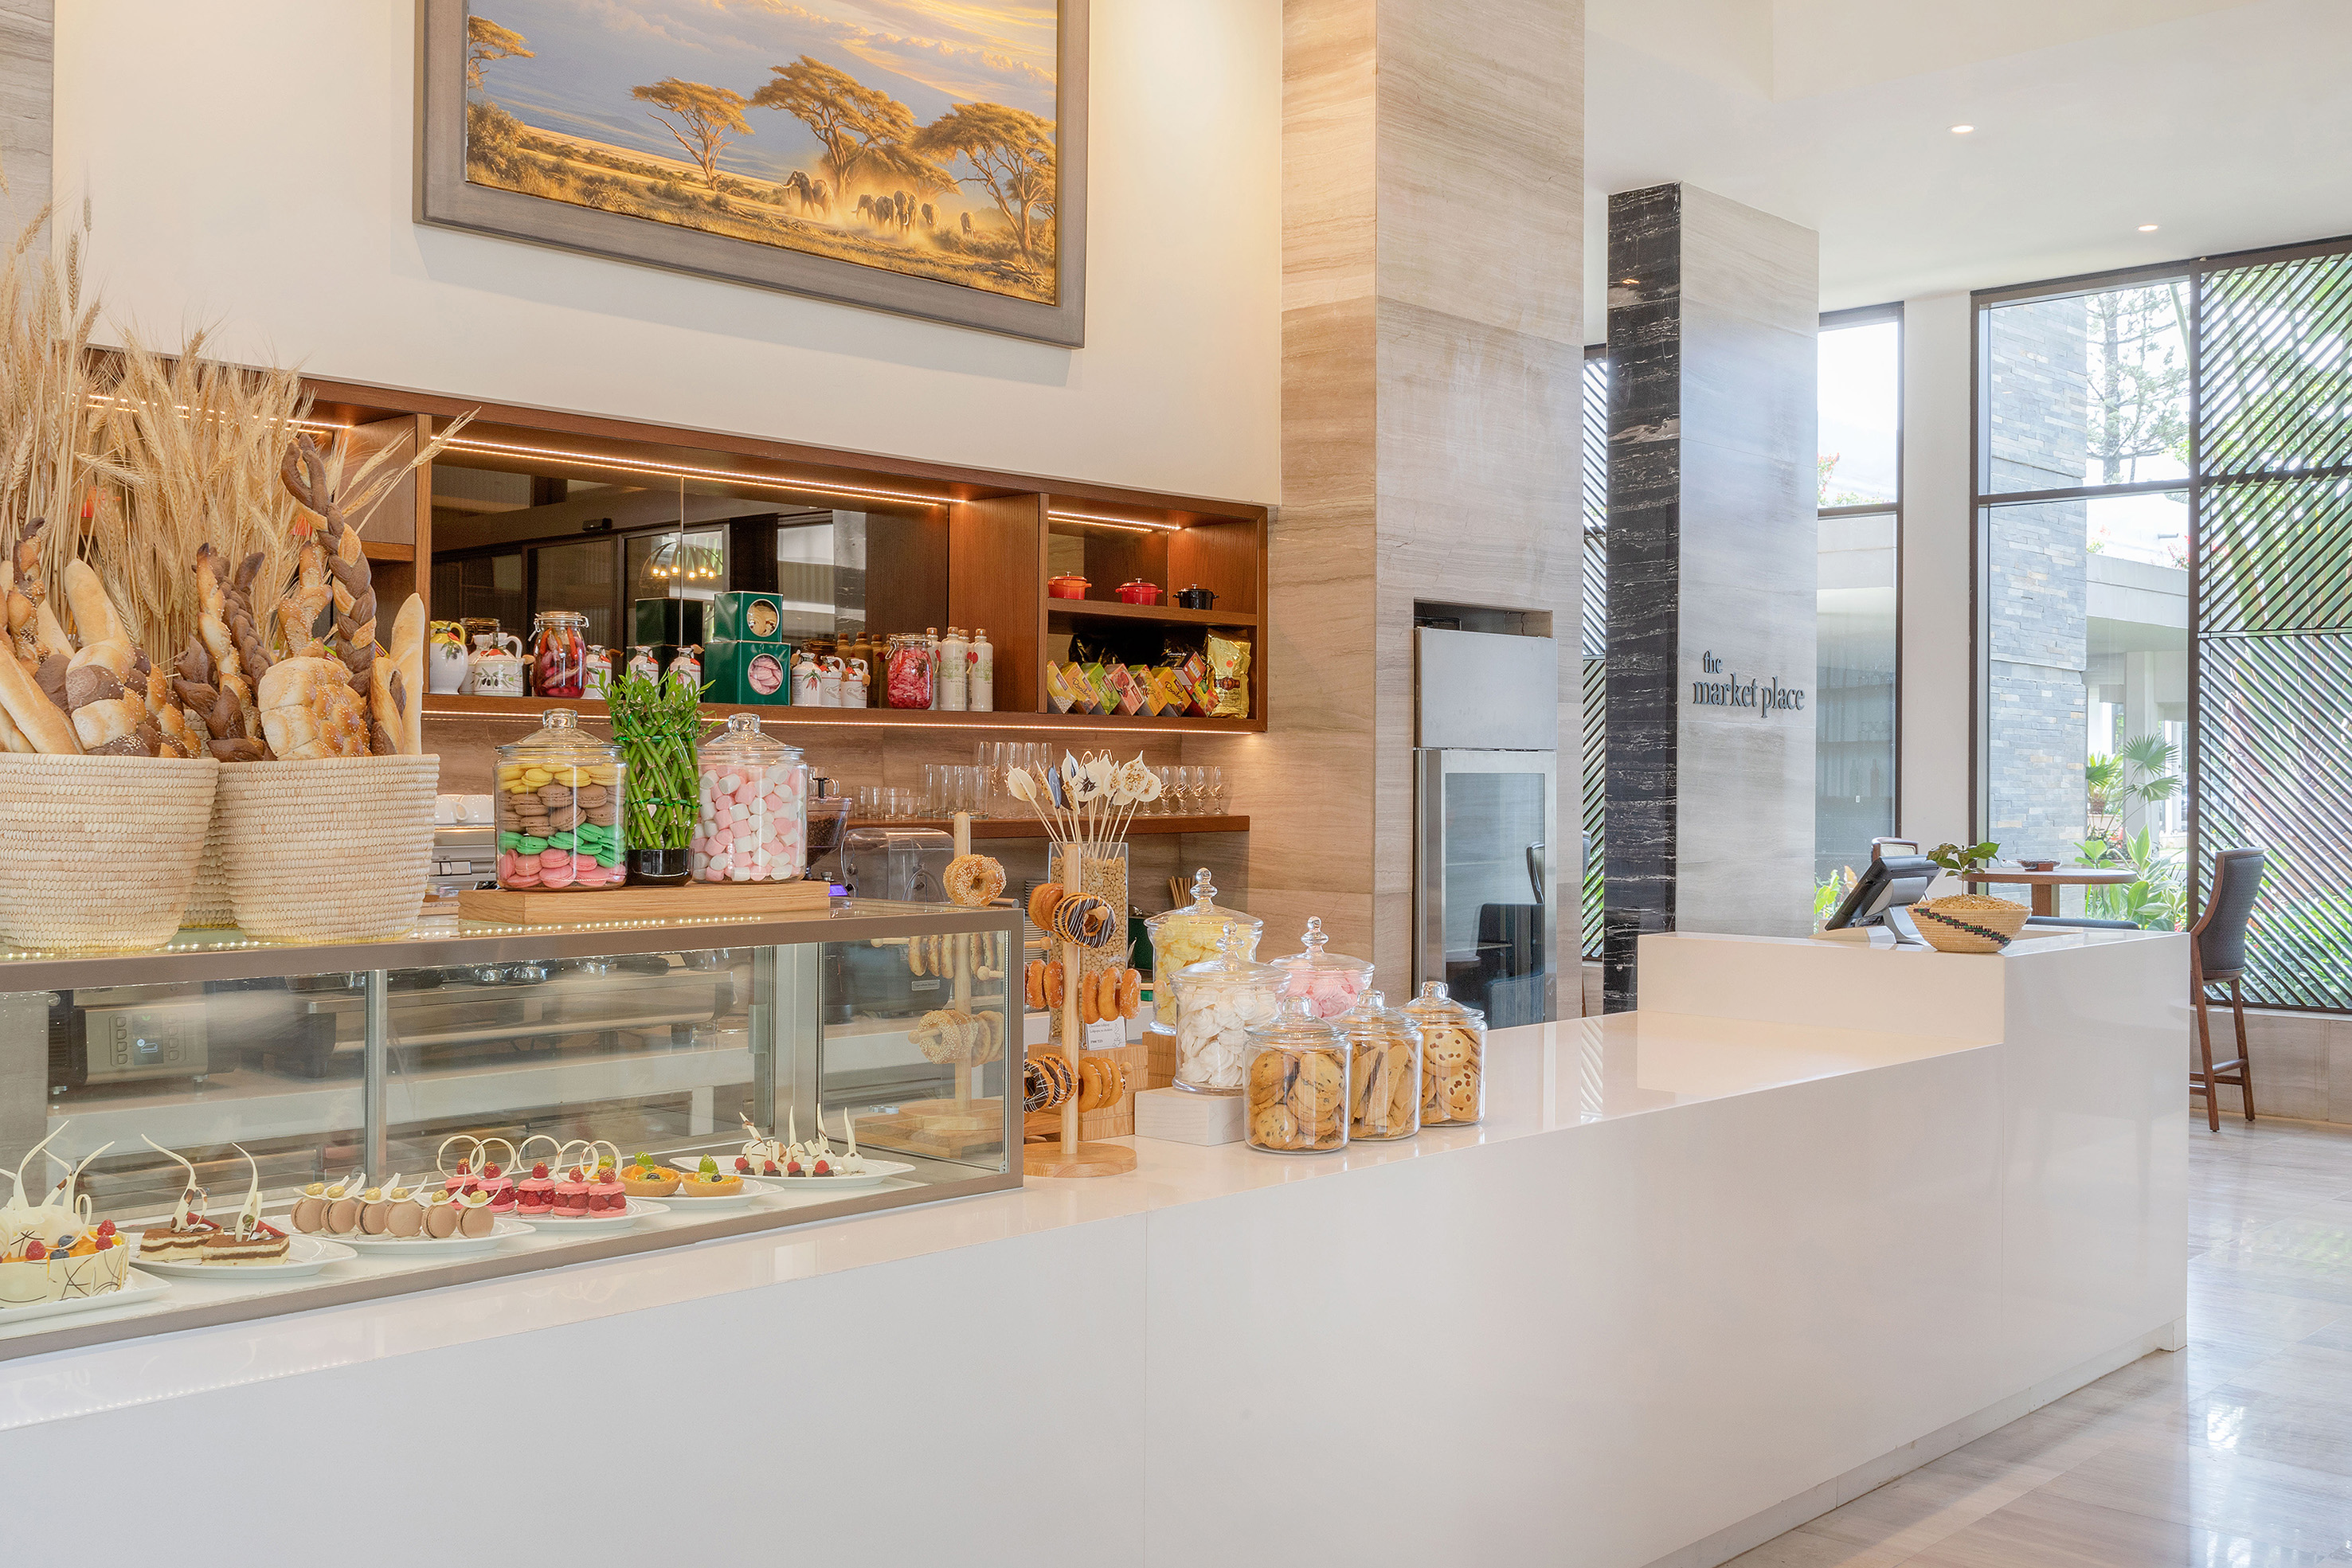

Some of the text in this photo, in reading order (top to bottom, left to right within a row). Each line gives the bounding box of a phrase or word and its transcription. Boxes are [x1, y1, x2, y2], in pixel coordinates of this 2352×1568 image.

[1703, 649, 1723, 674] the
[1693, 672, 1806, 718] market place
